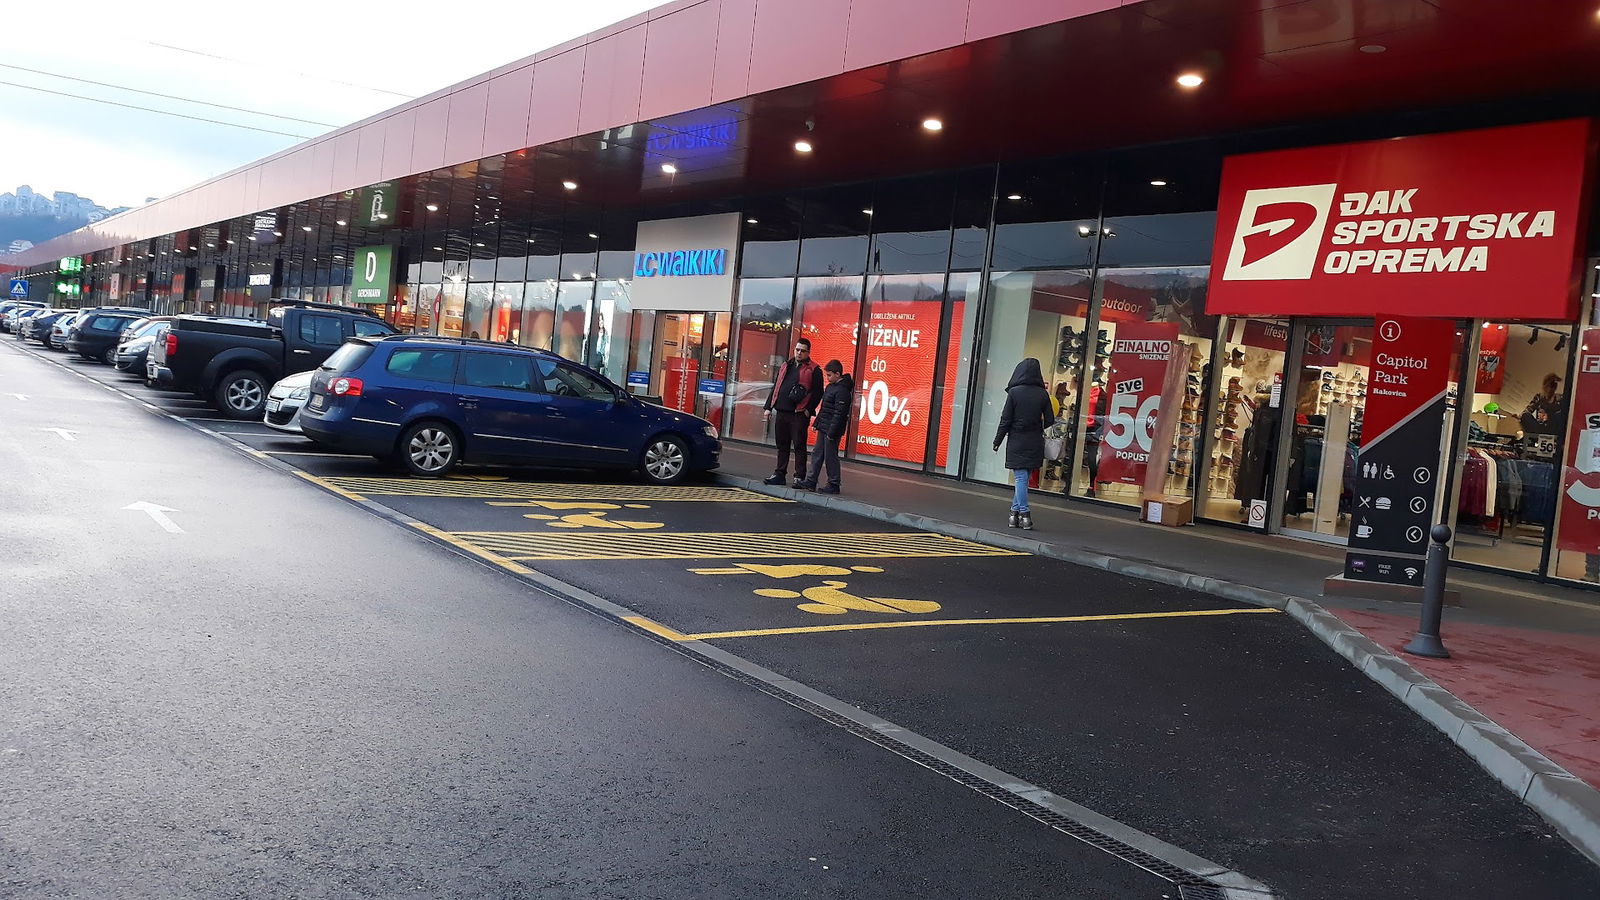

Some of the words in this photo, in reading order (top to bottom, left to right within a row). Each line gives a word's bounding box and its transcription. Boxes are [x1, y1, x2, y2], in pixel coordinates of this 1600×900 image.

[1332, 211, 1555, 245] SPORTSKA
[1324, 246, 1488, 274] OPREMA
[1116, 341, 1170, 353] FINALNO
[871, 356, 887, 372] do
[1377, 353, 1428, 370] Capitol
[1374, 370, 1408, 385] Park
[1117, 379, 1143, 394] sve
[1373, 388, 1407, 397] Rakovica
[1116, 451, 1150, 462] POPUST
